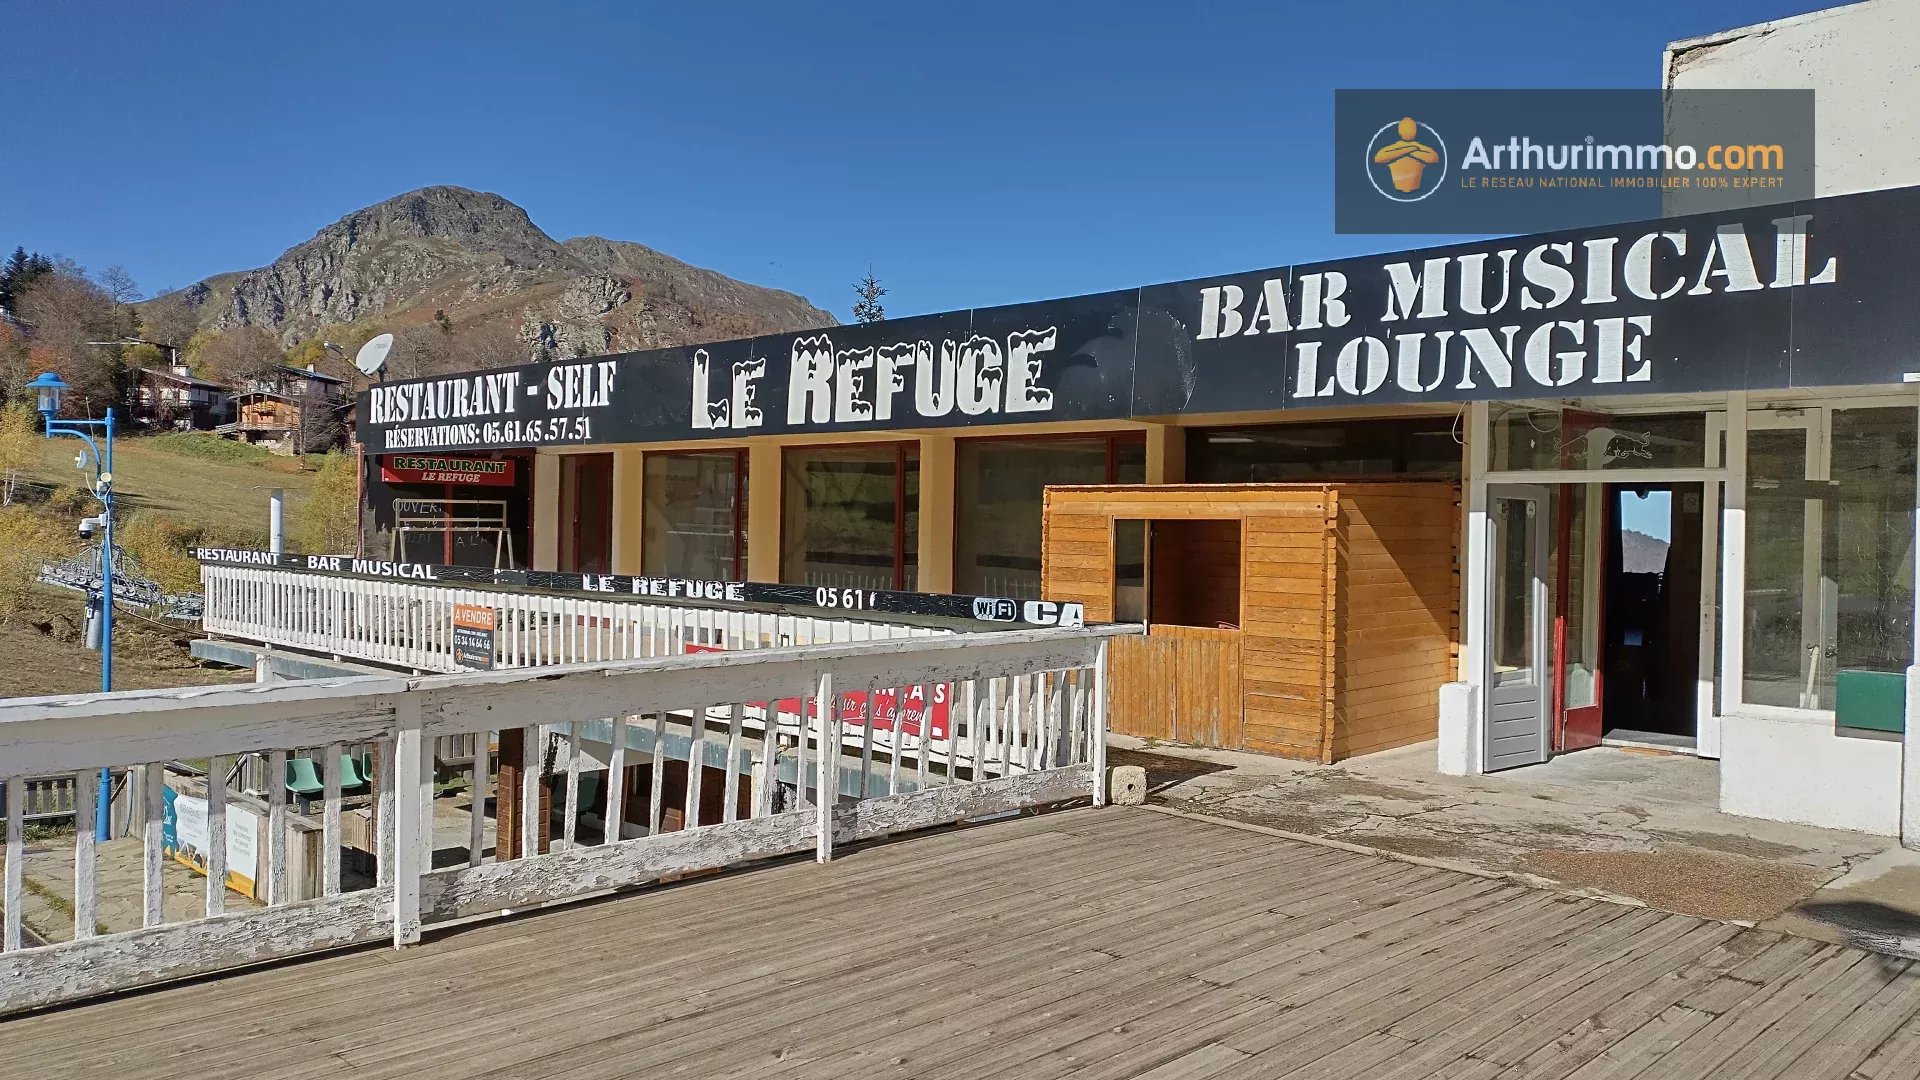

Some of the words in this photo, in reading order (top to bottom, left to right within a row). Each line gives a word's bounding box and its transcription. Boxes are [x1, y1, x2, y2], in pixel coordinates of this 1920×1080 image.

[1197, 271, 1351, 341] BAR
[1381, 215, 1837, 325] MUSICAL
[1293, 315, 1653, 399] LOUNGE
[691, 348, 765, 430] LE
[787, 326, 1057, 425] REFUGE
[369, 371, 519, 424] RESTAURANT
[547, 361, 617, 411] SELF
[385, 424, 479, 449] RÉSERVATIONS:
[394, 457, 506, 473] RESTAURANT
[421, 472, 435, 481] LE
[438, 473, 480, 483] REFUGE
[197, 548, 279, 566] RESTAURANT
[307, 555, 340, 571] BAR
[352, 562, 437, 579] MUSICAL
[582, 573, 615, 592] LE
[632, 576, 745, 601] REFUGE
[816, 587, 838, 608] 05
[842, 589, 862, 610] 61
[454, 608, 460, 621] A
[461, 609, 492, 626] VENDRE
